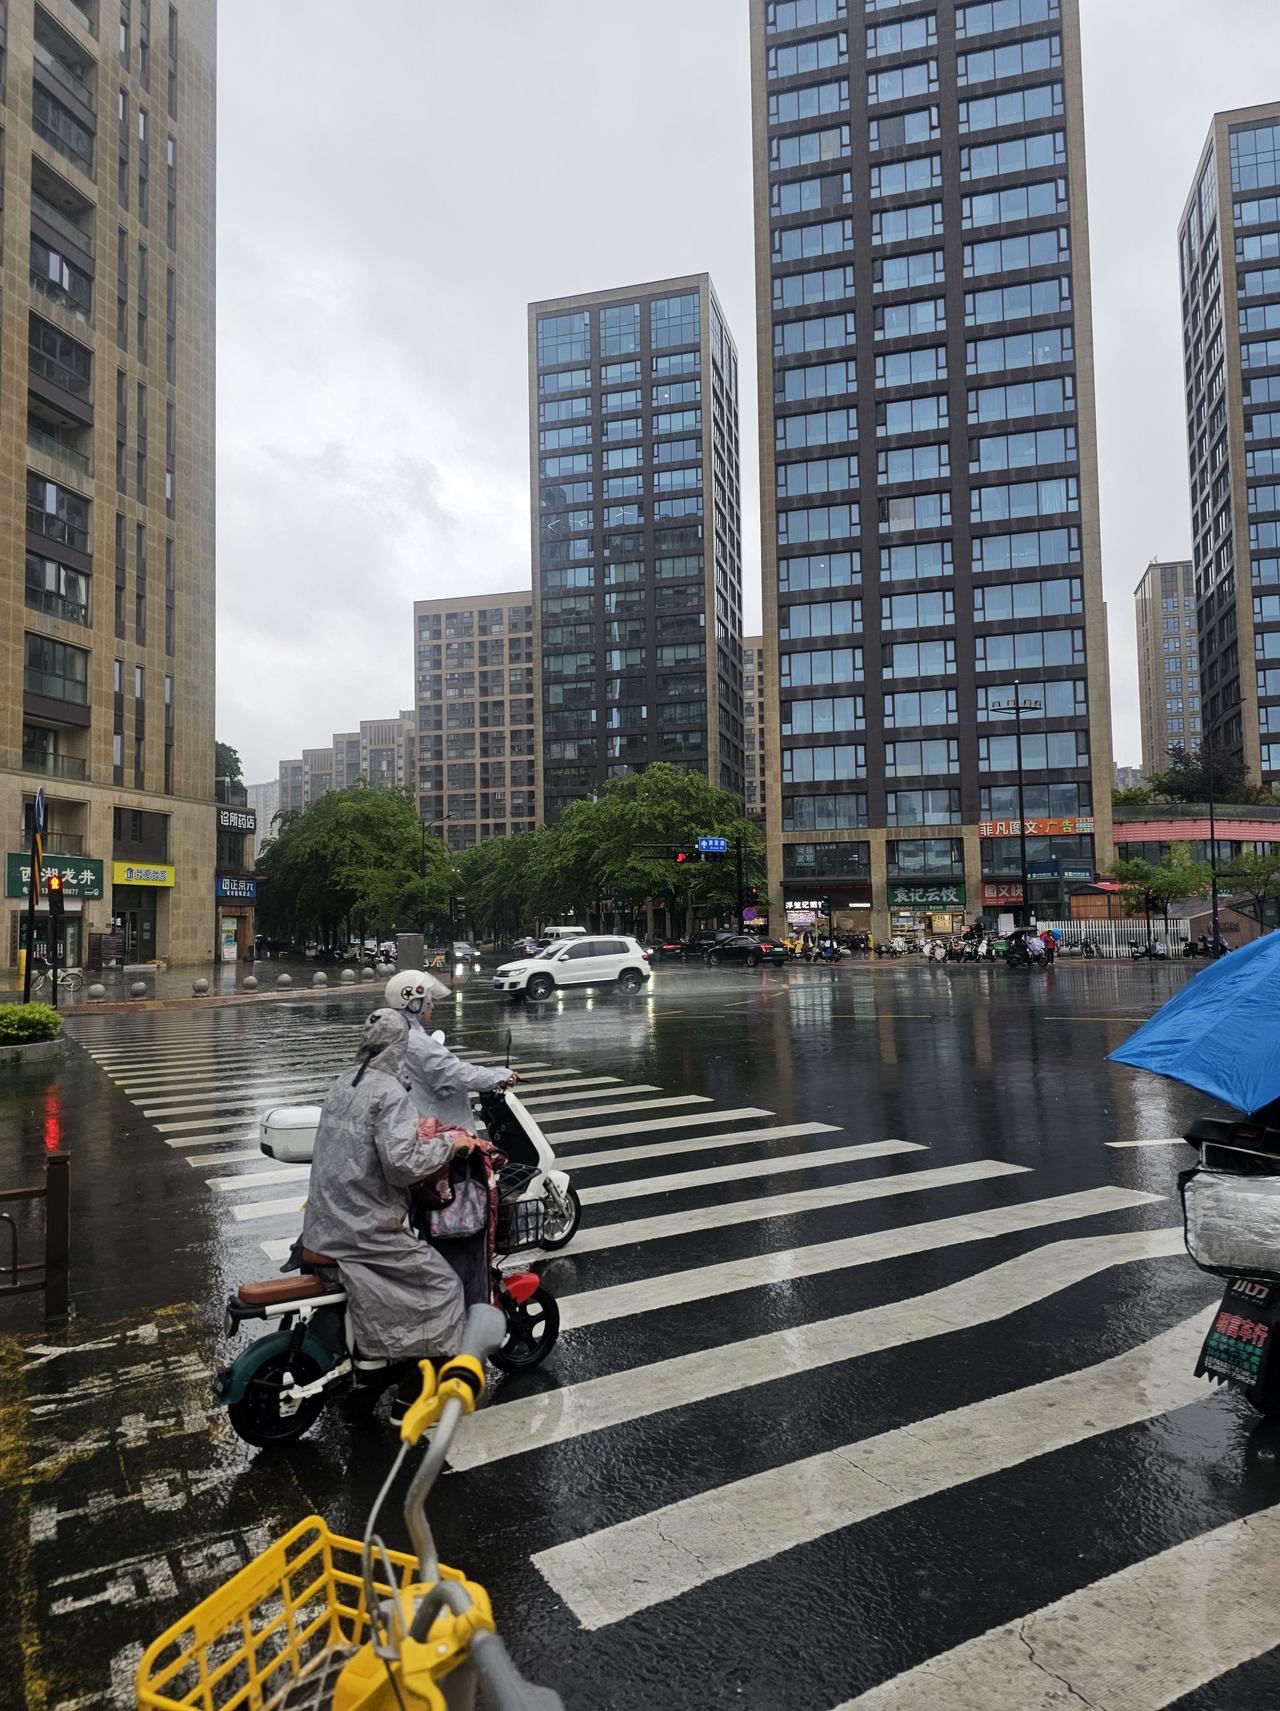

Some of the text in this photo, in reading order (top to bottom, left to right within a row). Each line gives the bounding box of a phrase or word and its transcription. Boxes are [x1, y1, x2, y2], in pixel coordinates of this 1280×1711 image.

[220, 811, 255, 829] 诊所药店
[893, 886, 959, 903] 袁记云饺
